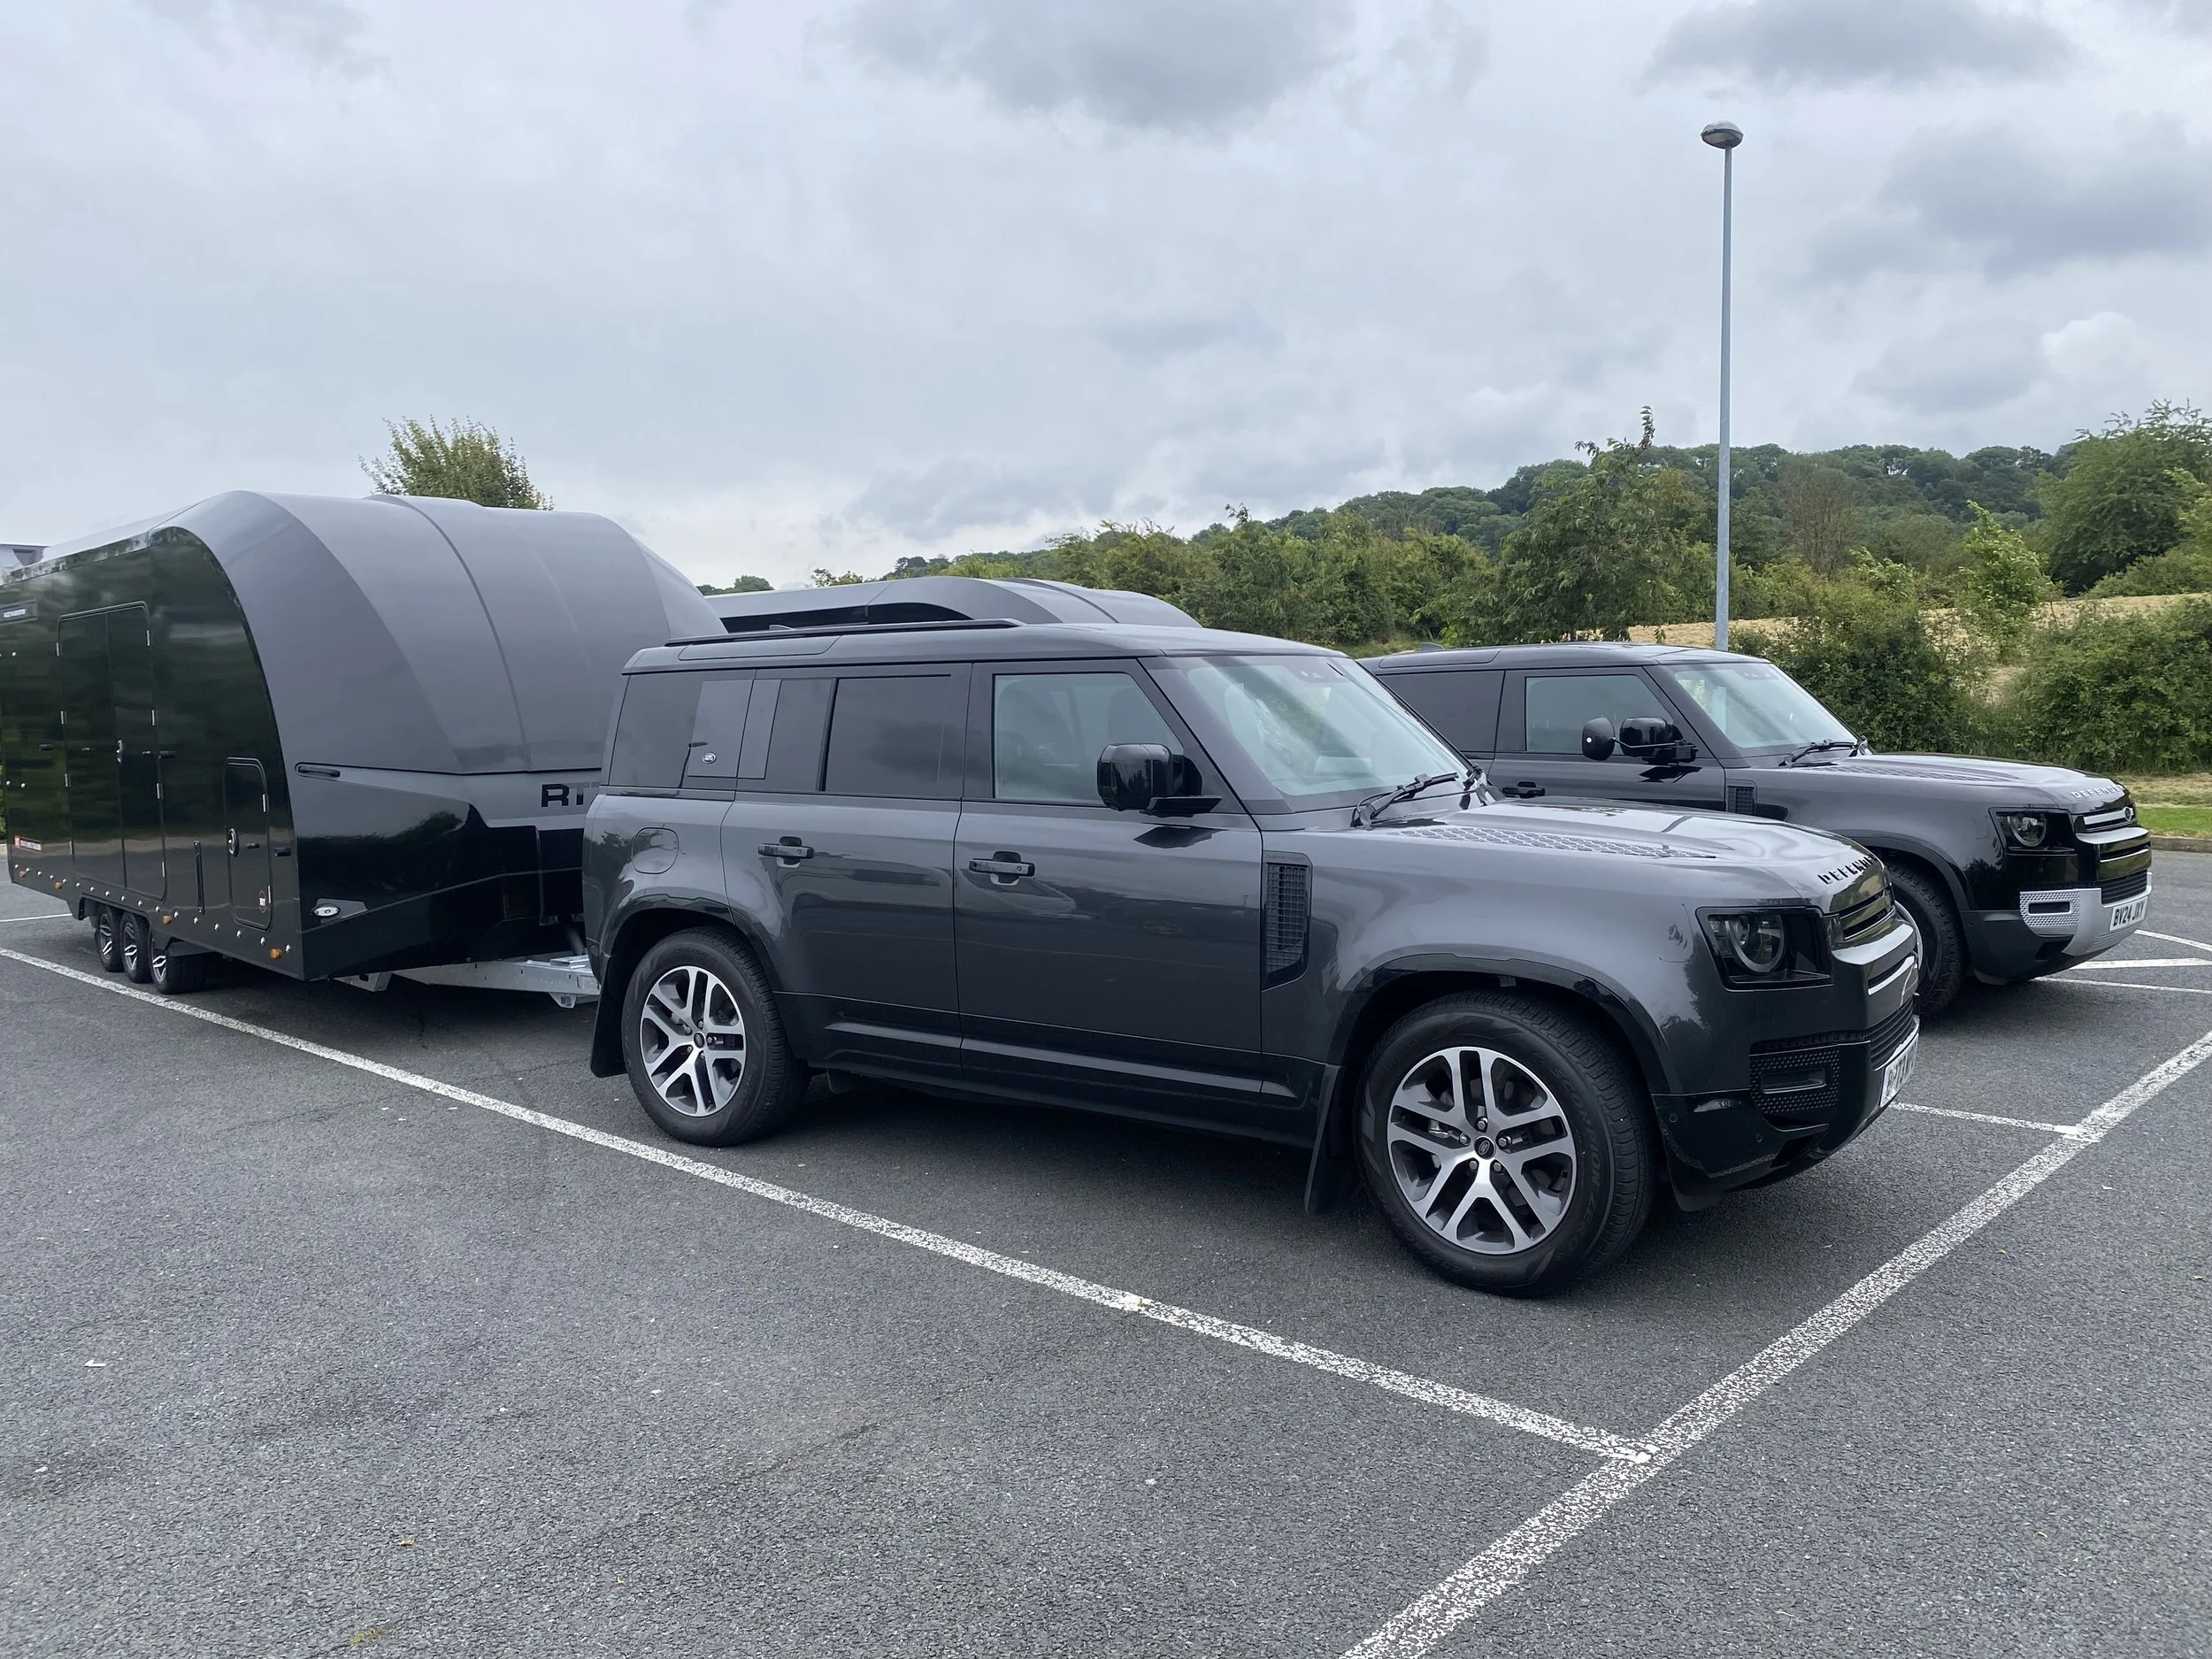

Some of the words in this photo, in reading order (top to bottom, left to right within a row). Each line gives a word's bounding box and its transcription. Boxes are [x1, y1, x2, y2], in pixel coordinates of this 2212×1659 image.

[2113, 904, 2132, 926] BV24
[1551, 1067, 1601, 1191] SCORPION
[1568, 1192, 1597, 1253] ZERO
